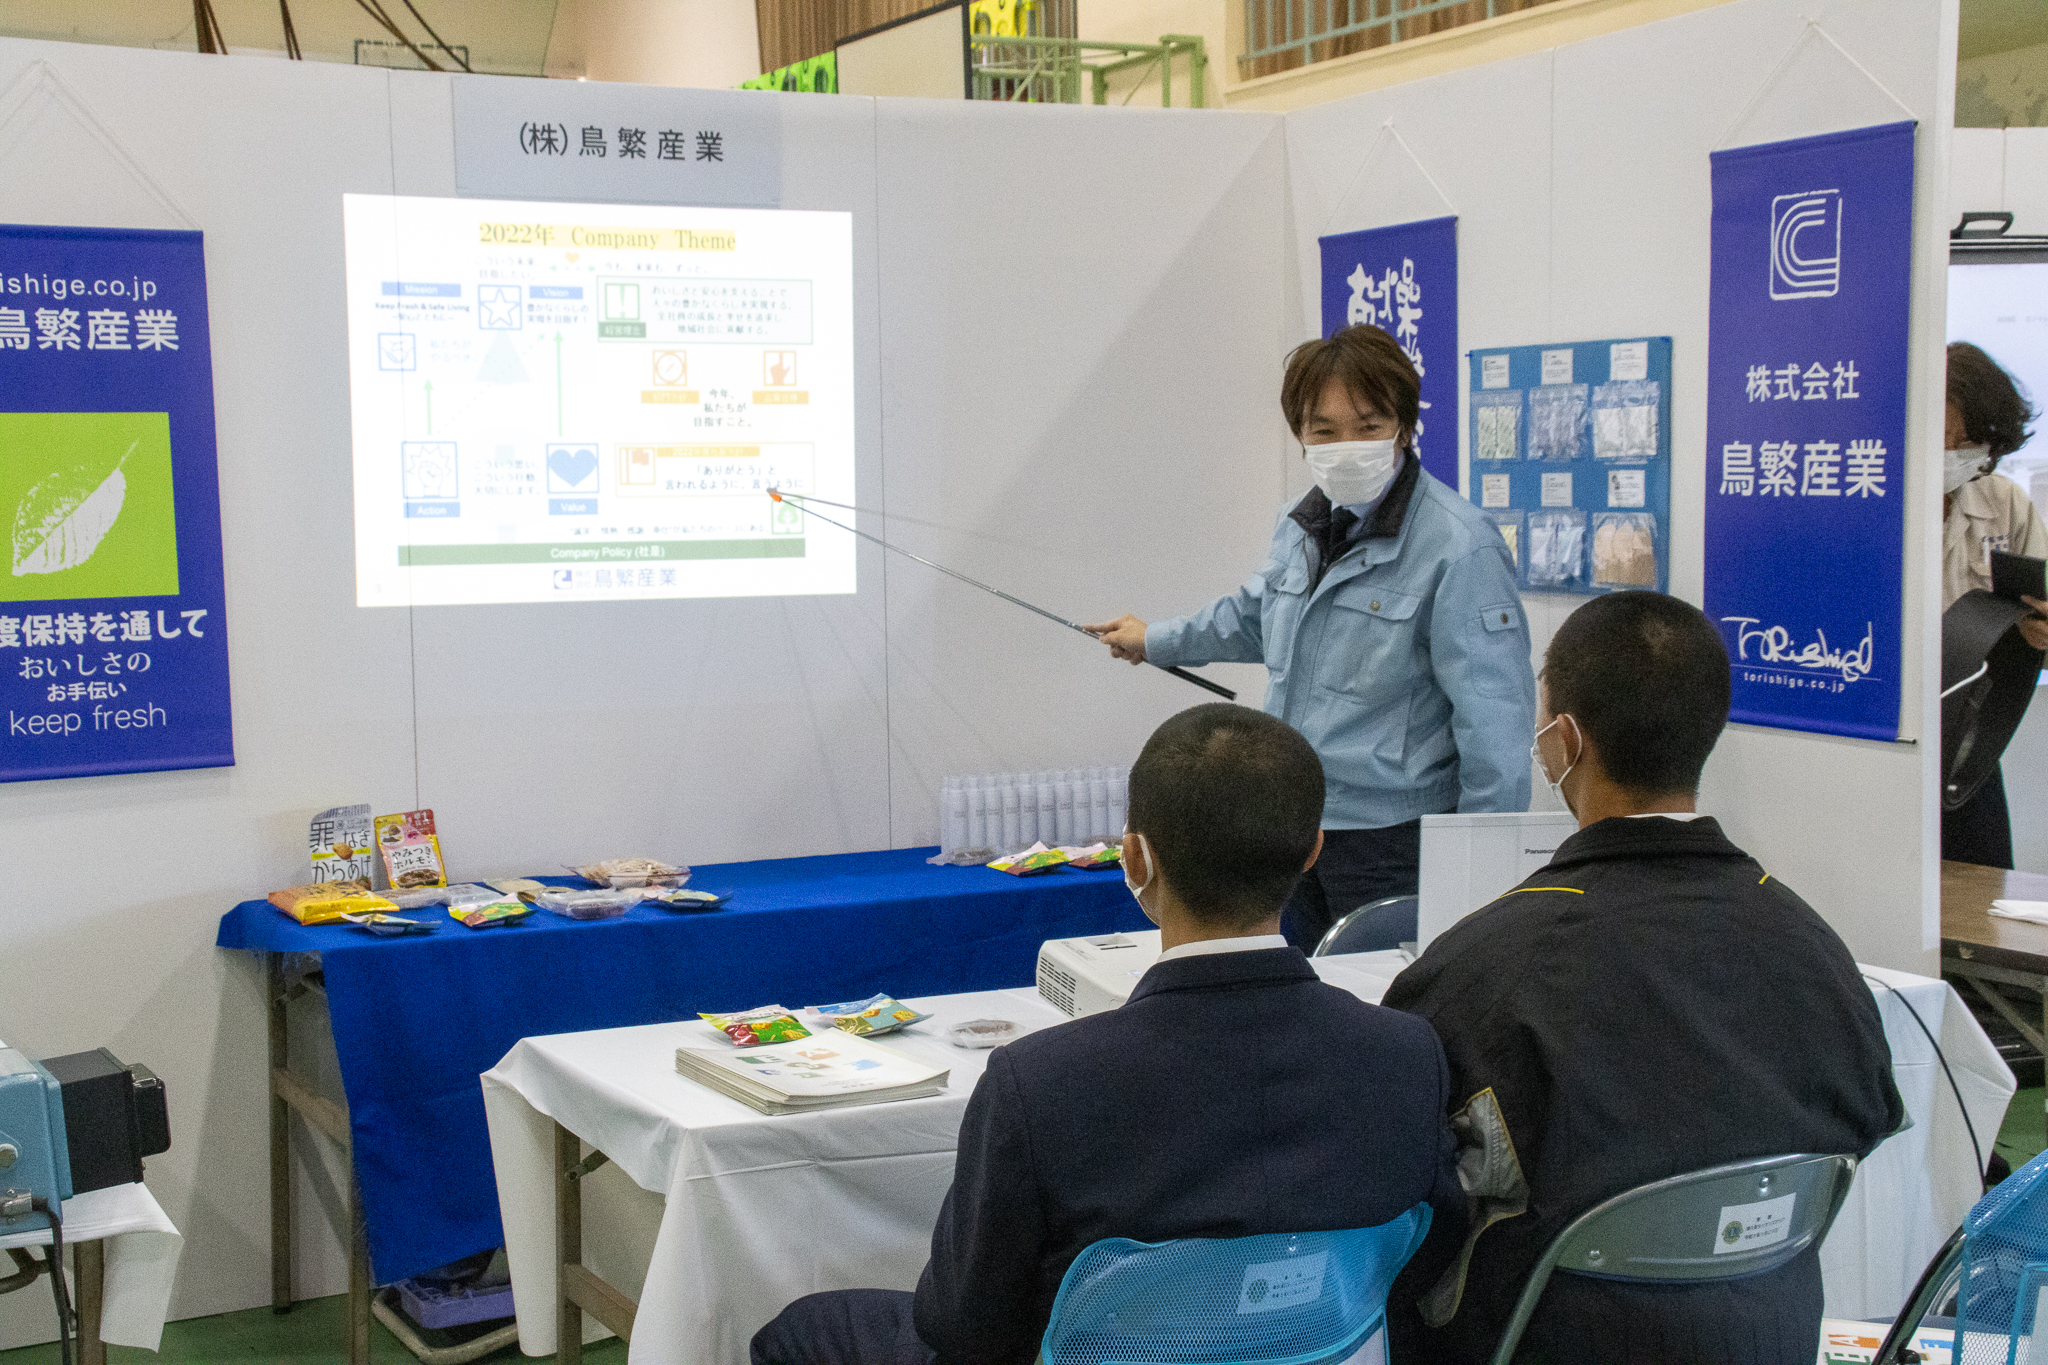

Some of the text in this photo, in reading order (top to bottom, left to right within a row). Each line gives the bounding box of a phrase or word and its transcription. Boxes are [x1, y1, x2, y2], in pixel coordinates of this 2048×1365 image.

[479, 222, 736, 250] 2022年 Company Theme
[405, 284, 438, 294] Mission
[543, 288, 569, 297] Vision
[375, 302, 395, 311] Keep
[398, 302, 418, 310] Fresh
[447, 304, 470, 312] Living
[0, 307, 179, 351] 鳥繁産業
[1746, 360, 1859, 402] 株式会社
[704, 403, 747, 413] 私たちが
[694, 416, 752, 428] 目指すこと。
[1719, 439, 1887, 499] 鳥繁産業
[417, 505, 447, 515] Action
[561, 502, 587, 512] Value
[551, 547, 600, 560] Company
[602, 546, 633, 559] Policy
[594, 567, 677, 588] 鳥繁産業
[0, 609, 208, 648] 度保持を通して
[19, 652, 151, 679] おいしさの
[47, 681, 127, 702] お手伝い
[1744, 671, 1846, 693] torishige.co.jp
[10, 702, 167, 736] keep fresh
